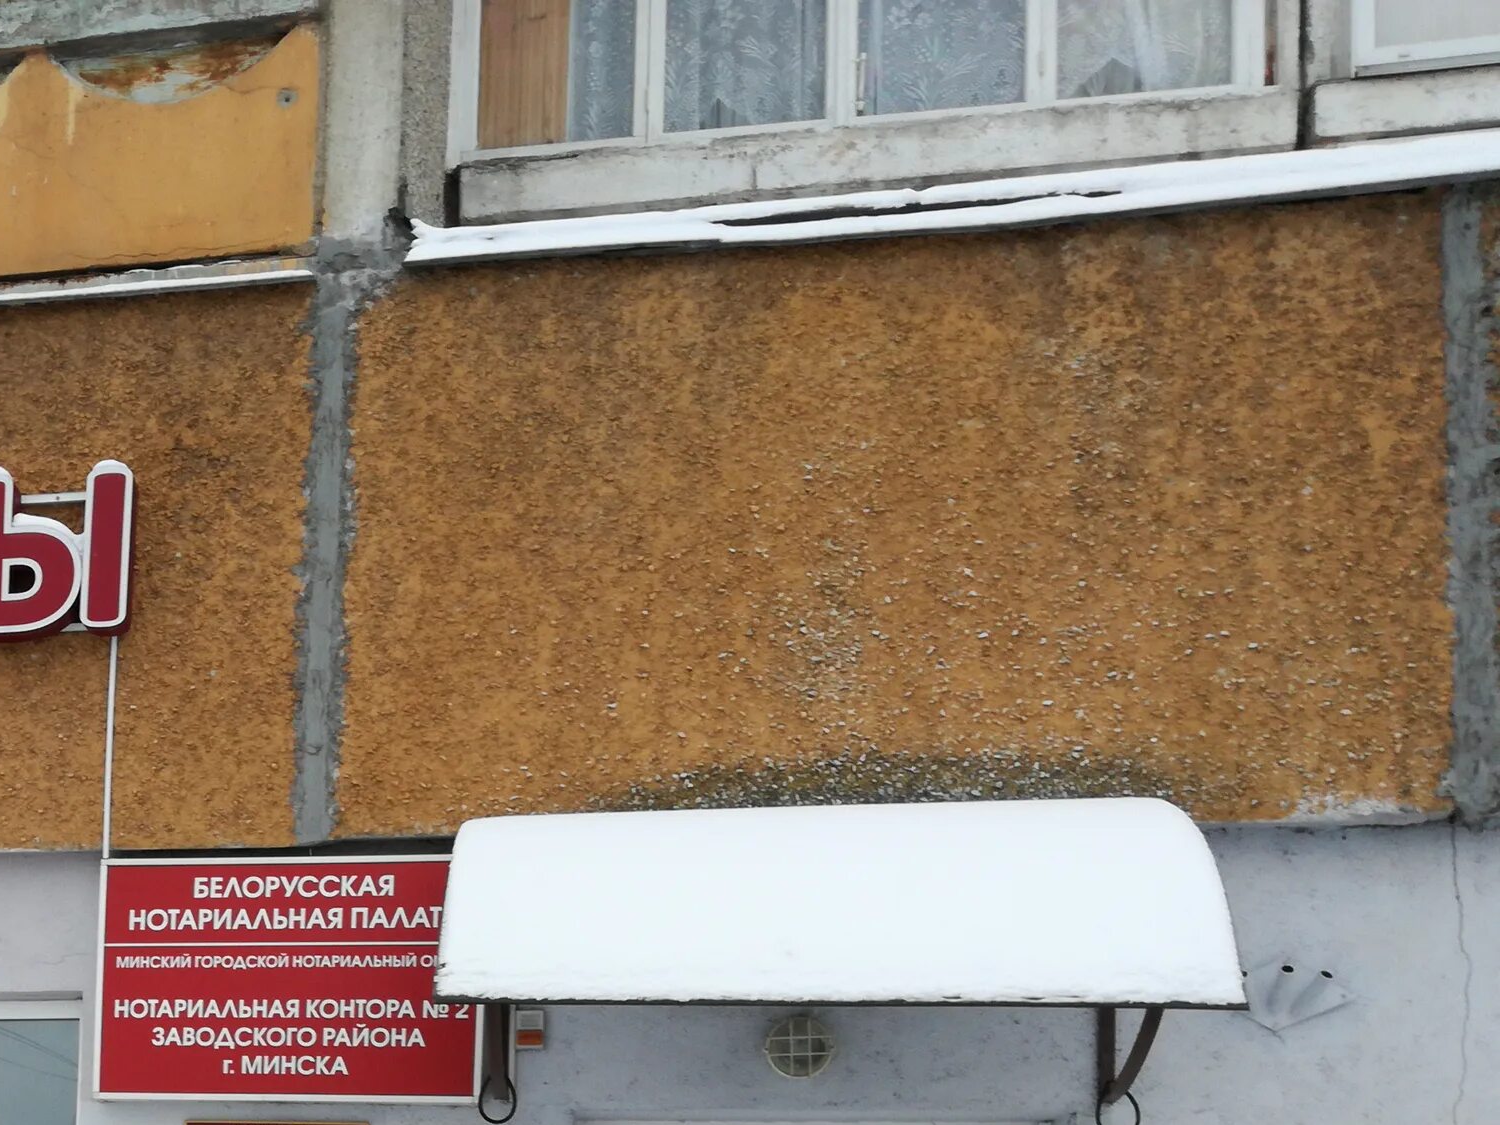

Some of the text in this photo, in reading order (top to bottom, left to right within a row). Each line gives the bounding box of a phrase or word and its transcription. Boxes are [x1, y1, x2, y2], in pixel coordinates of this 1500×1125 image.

[193, 874, 395, 899] БЕЛОРУССКАЯ
[128, 906, 442, 931] НОТАРИАЛЬНАЯ ПАЛАТ
[116, 953, 192, 969] МИНСКИЙ
[194, 952, 289, 970] ГОРОДСКОЙ
[292, 952, 416, 969] НОТАРИАЛЬНЫЙ
[114, 999, 469, 1019] НОТАРИАЛЬНАЯ КОНТОРА № 2
[151, 1024, 425, 1049] ЗАВОДСКОГО РАЙОНА
[222, 1056, 349, 1076] г. МИНСКА
